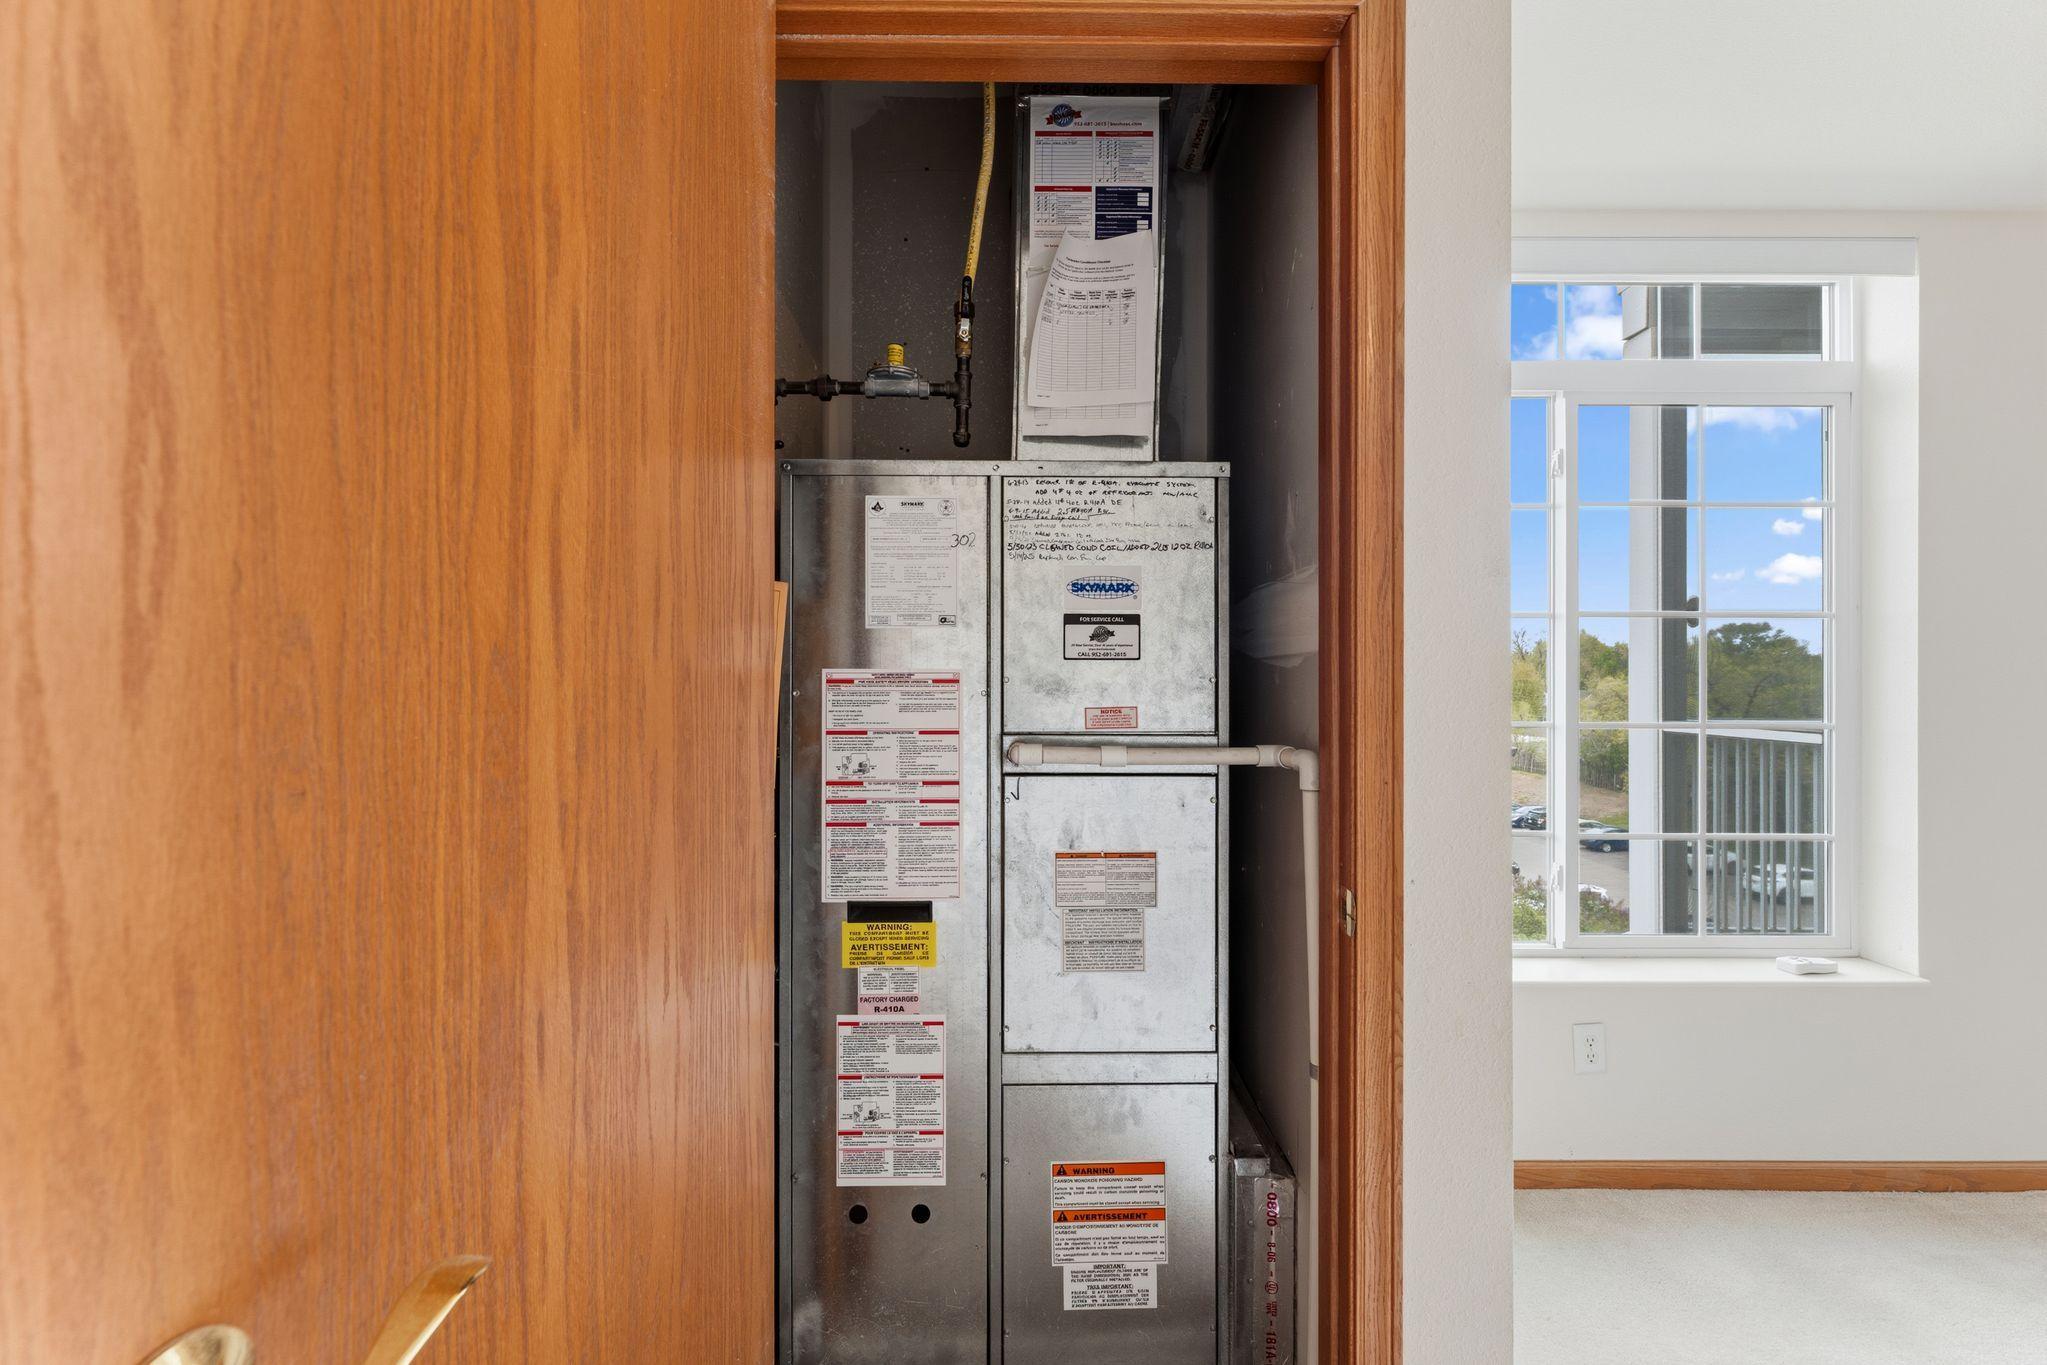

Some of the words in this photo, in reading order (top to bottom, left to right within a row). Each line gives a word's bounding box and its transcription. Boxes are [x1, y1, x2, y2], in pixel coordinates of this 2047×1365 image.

[951, 532, 976, 548] 302
[1071, 582, 1135, 594] SKYMARK
[1073, 1167, 1115, 1175] WARNING
[1267, 1192, 1278, 1227] 0800
[1073, 1213, 1147, 1221] AVERTISSEMENT
[1267, 1242, 1276, 1262] 8-06
